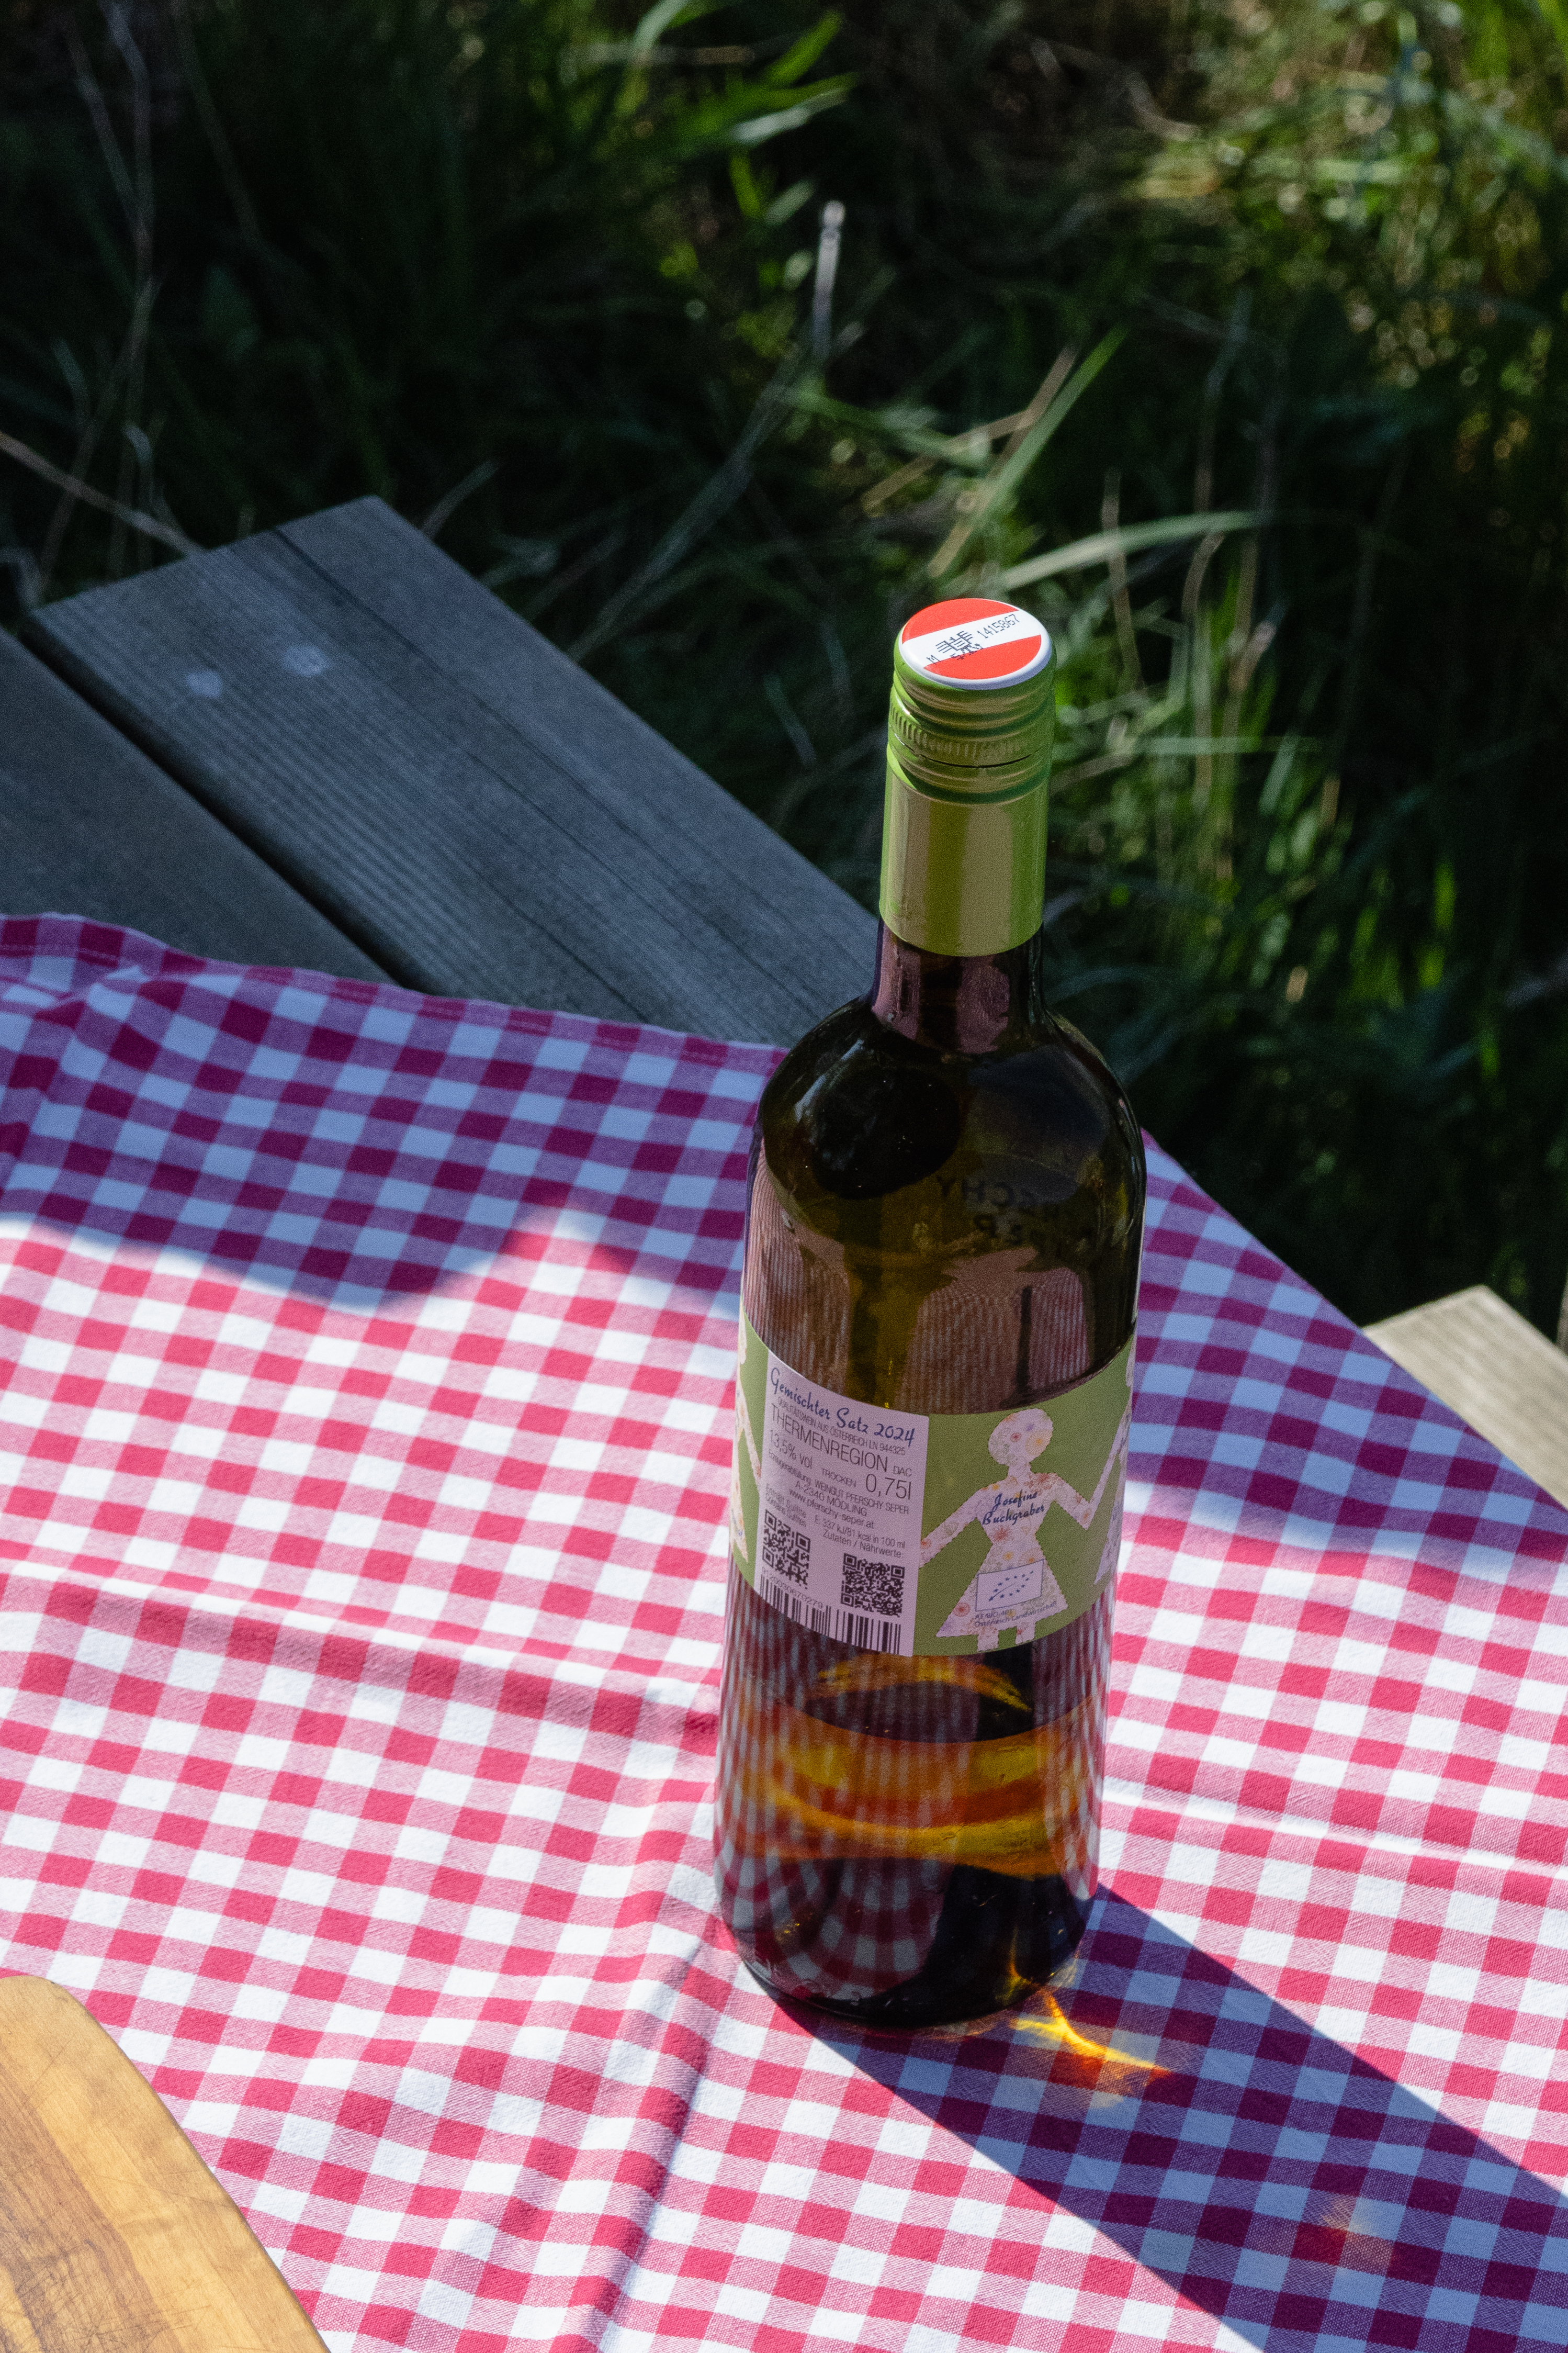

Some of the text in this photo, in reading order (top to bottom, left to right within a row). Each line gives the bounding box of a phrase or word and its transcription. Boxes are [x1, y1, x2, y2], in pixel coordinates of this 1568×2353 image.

[977, 614, 1020, 638] 1415867
[771, 1367, 915, 1447] Gemischter Satz 2024
[772, 1403, 912, 1477] THERMENREGION DAC
[817, 1421, 828, 1433] AUS
[830, 1426, 867, 1447] ÖSTERREICH
[869, 1440, 878, 1450] LN
[879, 1443, 905, 1455] 944325
[770, 1429, 911, 1500] 13,5% vol TROCKEN 0,75l
[789, 1489, 874, 1529] www.pferschy-seper.at
[795, 1481, 867, 1517] A-2340 MÖDLING
[815, 1480, 843, 1499] WEINGUT
[846, 1492, 883, 1509] PFERSCHY
[885, 1503, 909, 1514] SEPER
[991, 1489, 1037, 1512] Josefine
[982, 1503, 1044, 1526] Buchgraber
[823, 1529, 851, 1546] Zutaten
[858, 1530, 871, 1542] kcal
[873, 1534, 878, 1543] in
[881, 1536, 895, 1547] 100
[897, 1540, 905, 1548] ml
